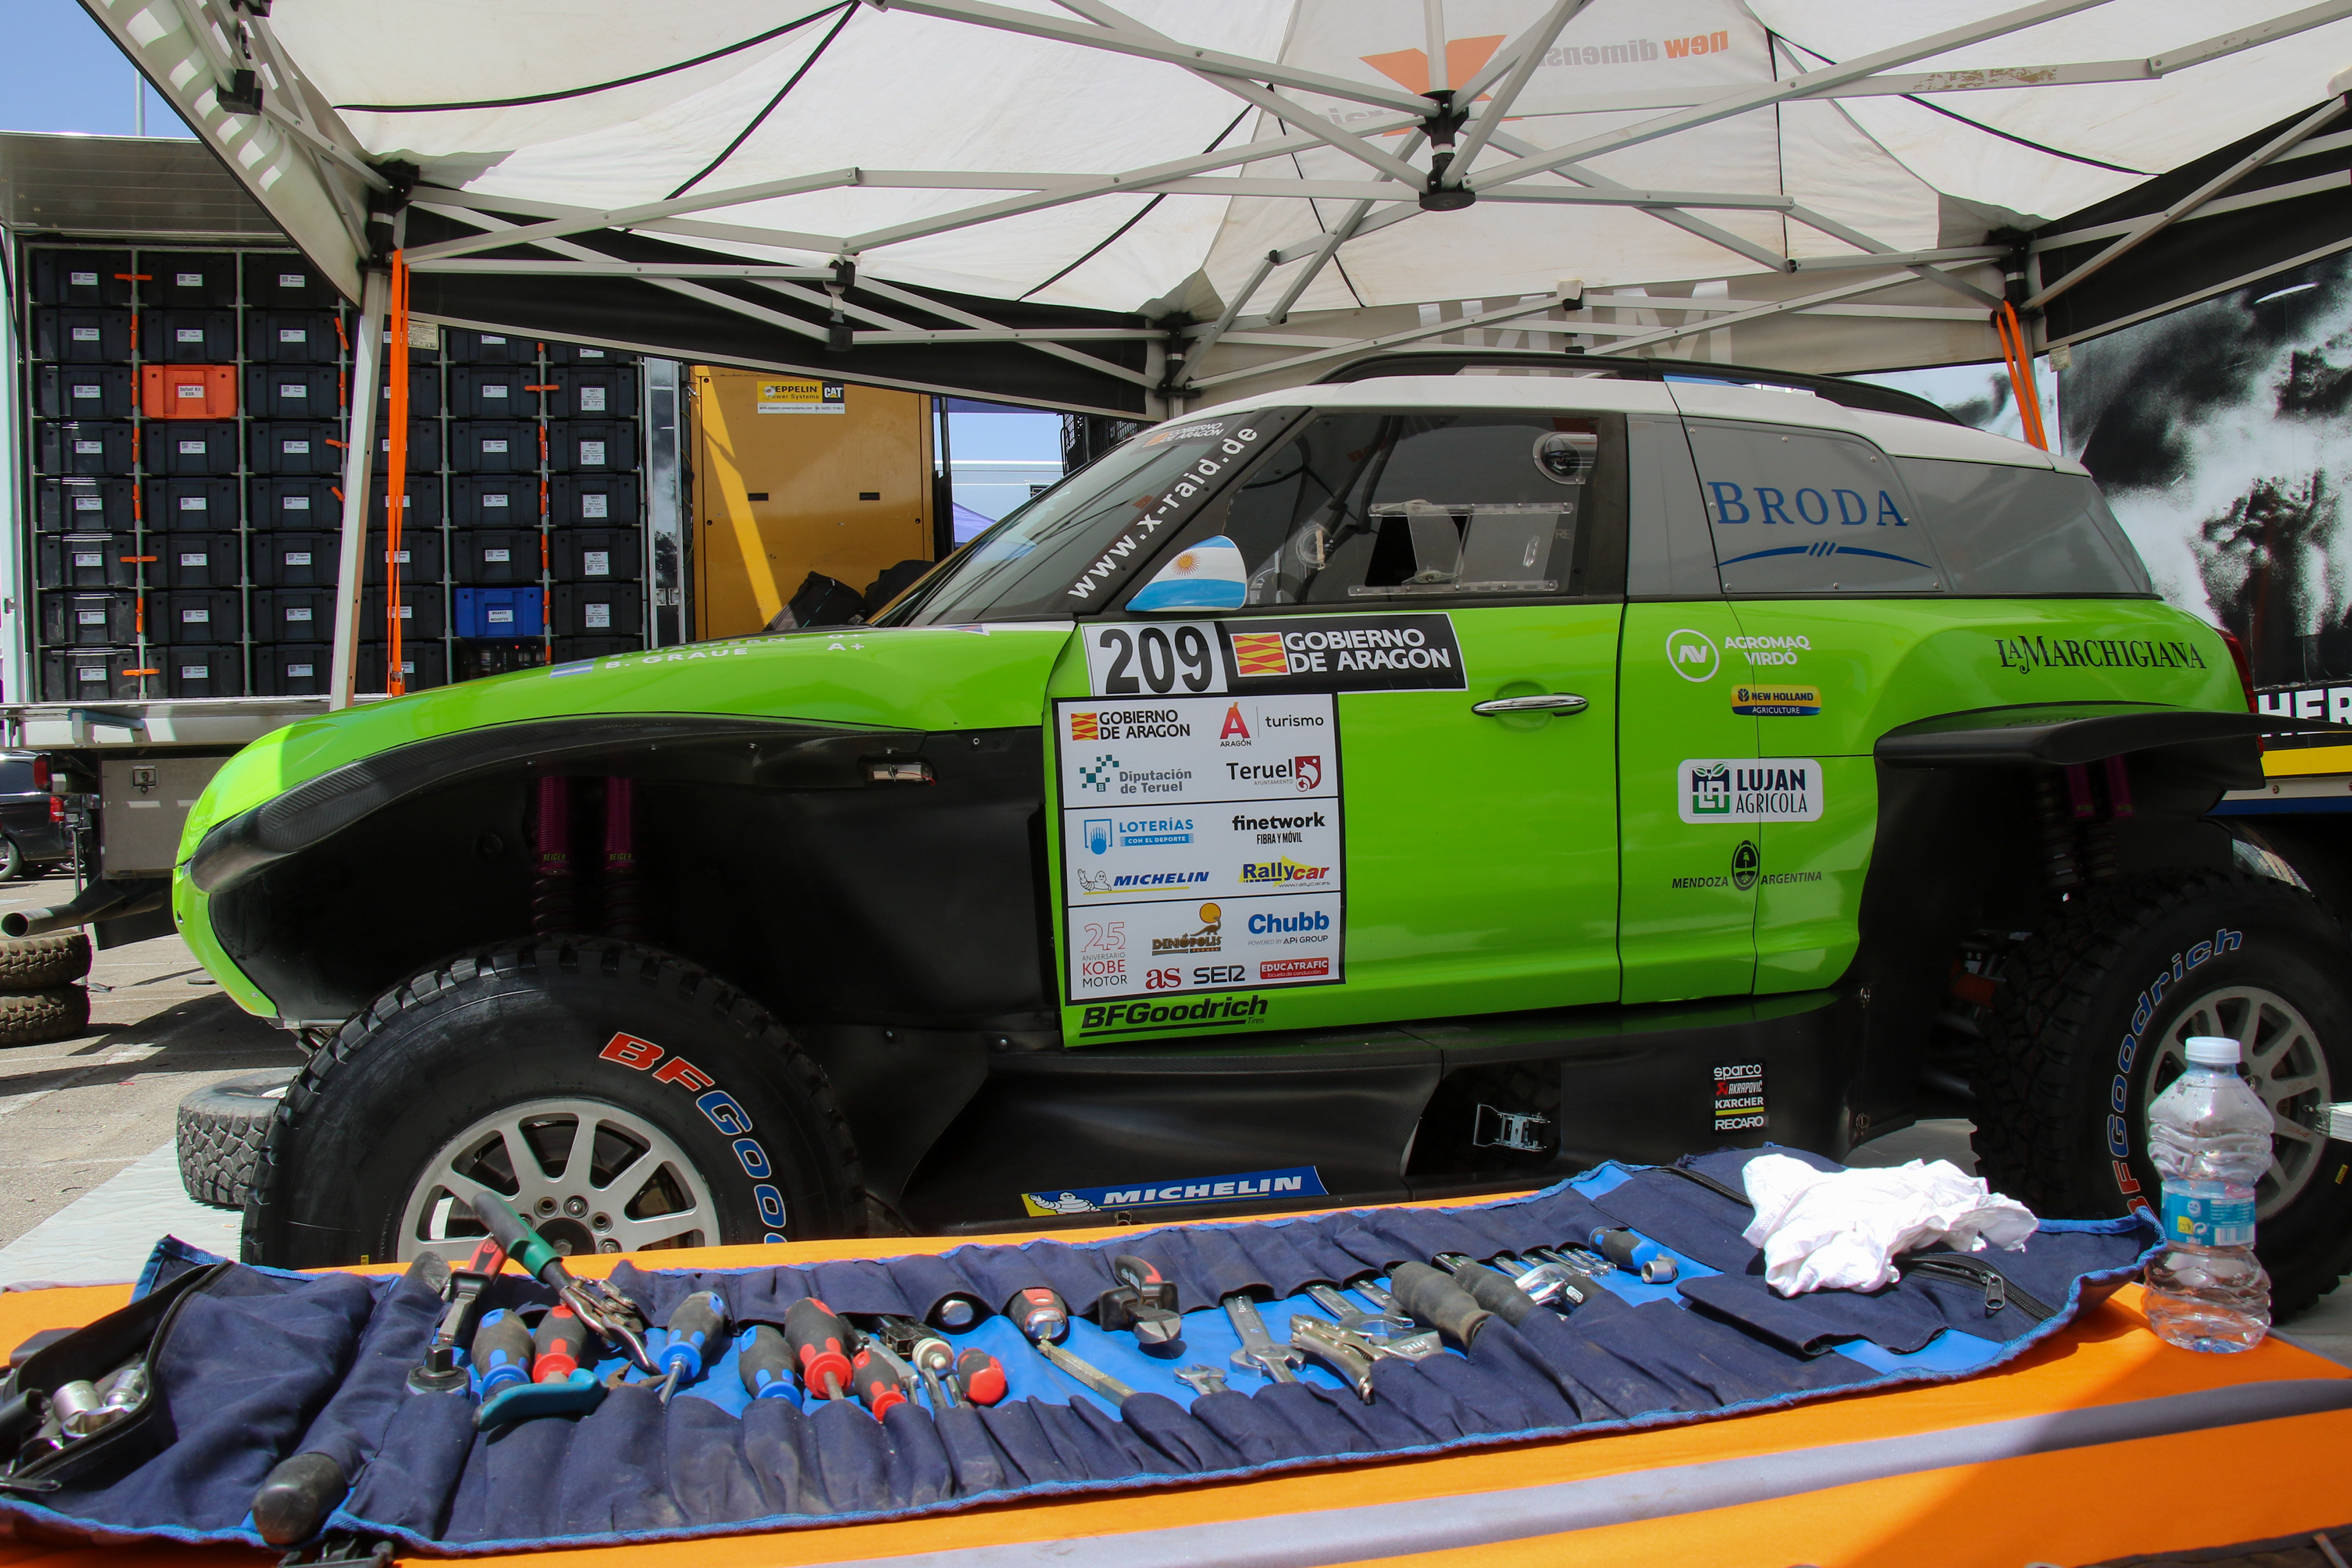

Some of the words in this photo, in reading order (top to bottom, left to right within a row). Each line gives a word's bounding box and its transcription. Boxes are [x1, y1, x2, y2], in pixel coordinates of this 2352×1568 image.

[824, 387, 842, 398] CAT
[1169, 422, 1223, 436] GOBIERNO
[1177, 429, 1224, 440] ARAGON
[1706, 481, 1908, 526] BRODA
[1068, 428, 1257, 599] www.x-raid.de
[1285, 628, 1426, 652] GOBIERNO
[1724, 635, 1812, 650] AGROMAQ
[605, 661, 630, 669] B.
[642, 648, 748, 664] GRAUE
[1099, 627, 1213, 695] 209
[1289, 652, 1327, 674] DE
[1336, 647, 1452, 673] ARAGON
[1743, 648, 1798, 666] VIRDÓ
[1751, 692, 1771, 701] NEW
[1773, 692, 1814, 701] HOLLAND
[1098, 709, 1179, 725] GOBIERNO
[1752, 706, 1801, 715] AGRICULTURE
[1265, 714, 1324, 728] turismo
[1099, 726, 1120, 740] DE
[1125, 723, 1191, 739] ARAGON
[1219, 739, 1252, 747] ARAGÓN
[1119, 767, 1193, 786] Diputación
[1226, 758, 1294, 781] Teruel
[1120, 783, 1137, 794] de
[1140, 780, 1183, 794] Teruel
[1736, 769, 1806, 791] LUJAN
[1735, 793, 1807, 813] AGRICOLA
[1119, 816, 1194, 834] LOTERÍAS
[1232, 812, 1325, 831] finetwork
[1155, 835, 1186, 843] DEPORTE
[1256, 834, 1275, 845] FIBRA
[1275, 834, 1282, 844] Y
[1282, 831, 1303, 844] MÓVIL
[609, 853, 632, 861] REIGER
[1113, 870, 1210, 887] MICHELIN
[1243, 862, 1330, 883] Rallycar
[1672, 876, 1728, 889] MENDOZA
[1760, 871, 1822, 886] ARGENTINA
[1248, 910, 1330, 935] Chubb
[1080, 921, 1126, 953] 25
[1283, 936, 1298, 944] APi
[1299, 934, 1329, 944] GROUP
[1082, 952, 1126, 961] ANIVERSARIO
[1082, 959, 1126, 976] KOBE
[1261, 960, 1328, 972] EDUCATRAFIC
[1082, 974, 1128, 989] MOTOR
[1145, 967, 1182, 990] as
[1193, 965, 1245, 985] SER
[1081, 995, 1268, 1029] BFGoodrich
[1713, 1064, 1762, 1081] sparco
[1714, 1096, 1764, 1109] KÄRCHER
[1714, 1115, 1764, 1131] RECARO
[1102, 1175, 1303, 1204] MICHELIN
